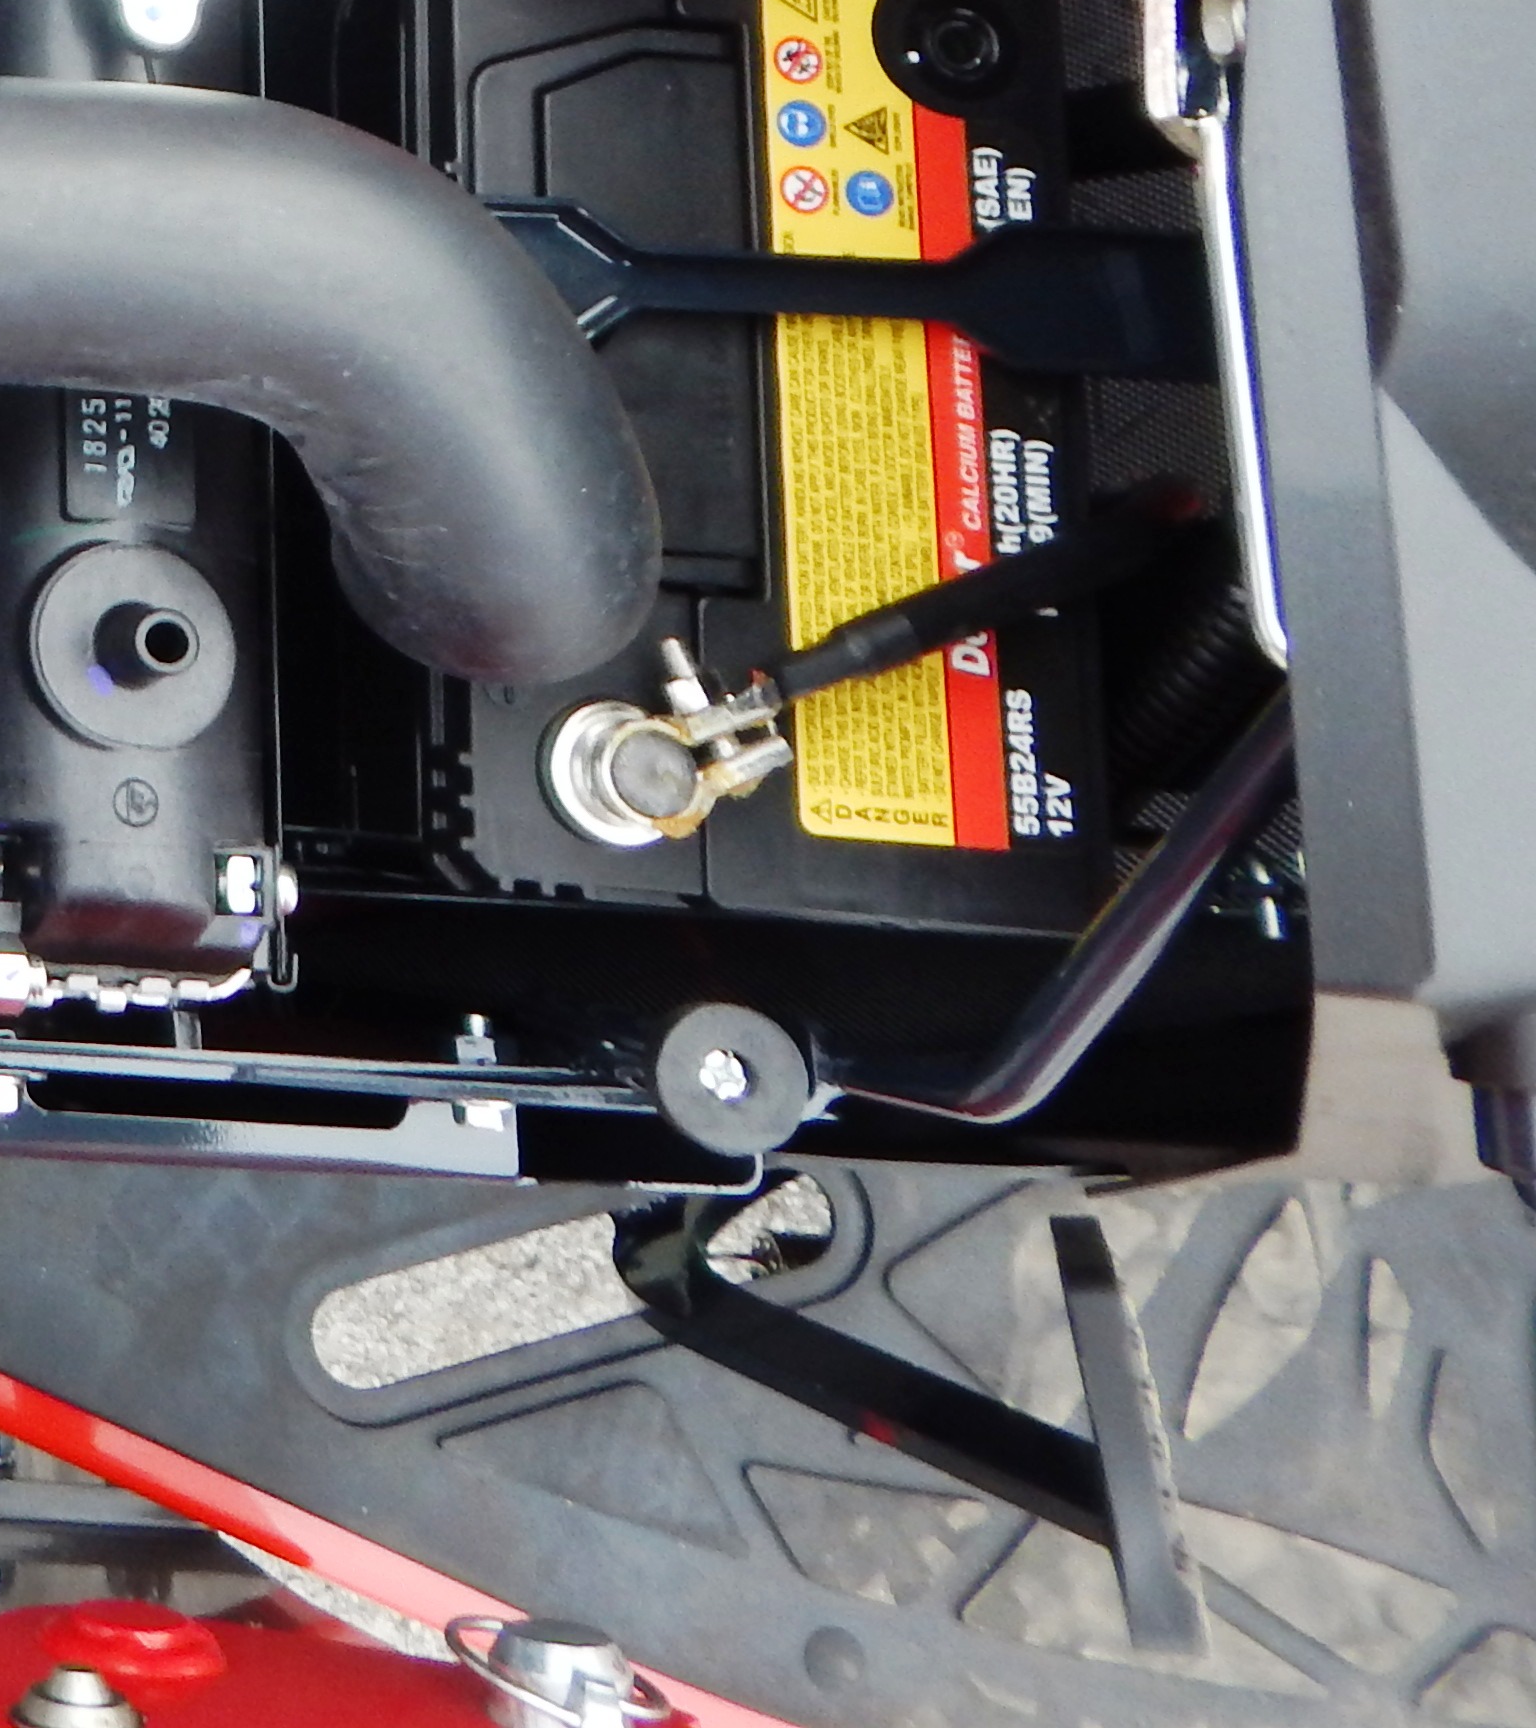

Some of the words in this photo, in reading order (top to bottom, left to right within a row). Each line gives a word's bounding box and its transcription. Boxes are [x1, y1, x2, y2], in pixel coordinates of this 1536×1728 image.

[1004, 166, 1036, 222] EN)
[957, 423, 983, 531] CALCIUM
[1006, 688, 1041, 837] 55B24RS
[835, 803, 949, 829] DANGER
[1044, 772, 1075, 839] 12V
